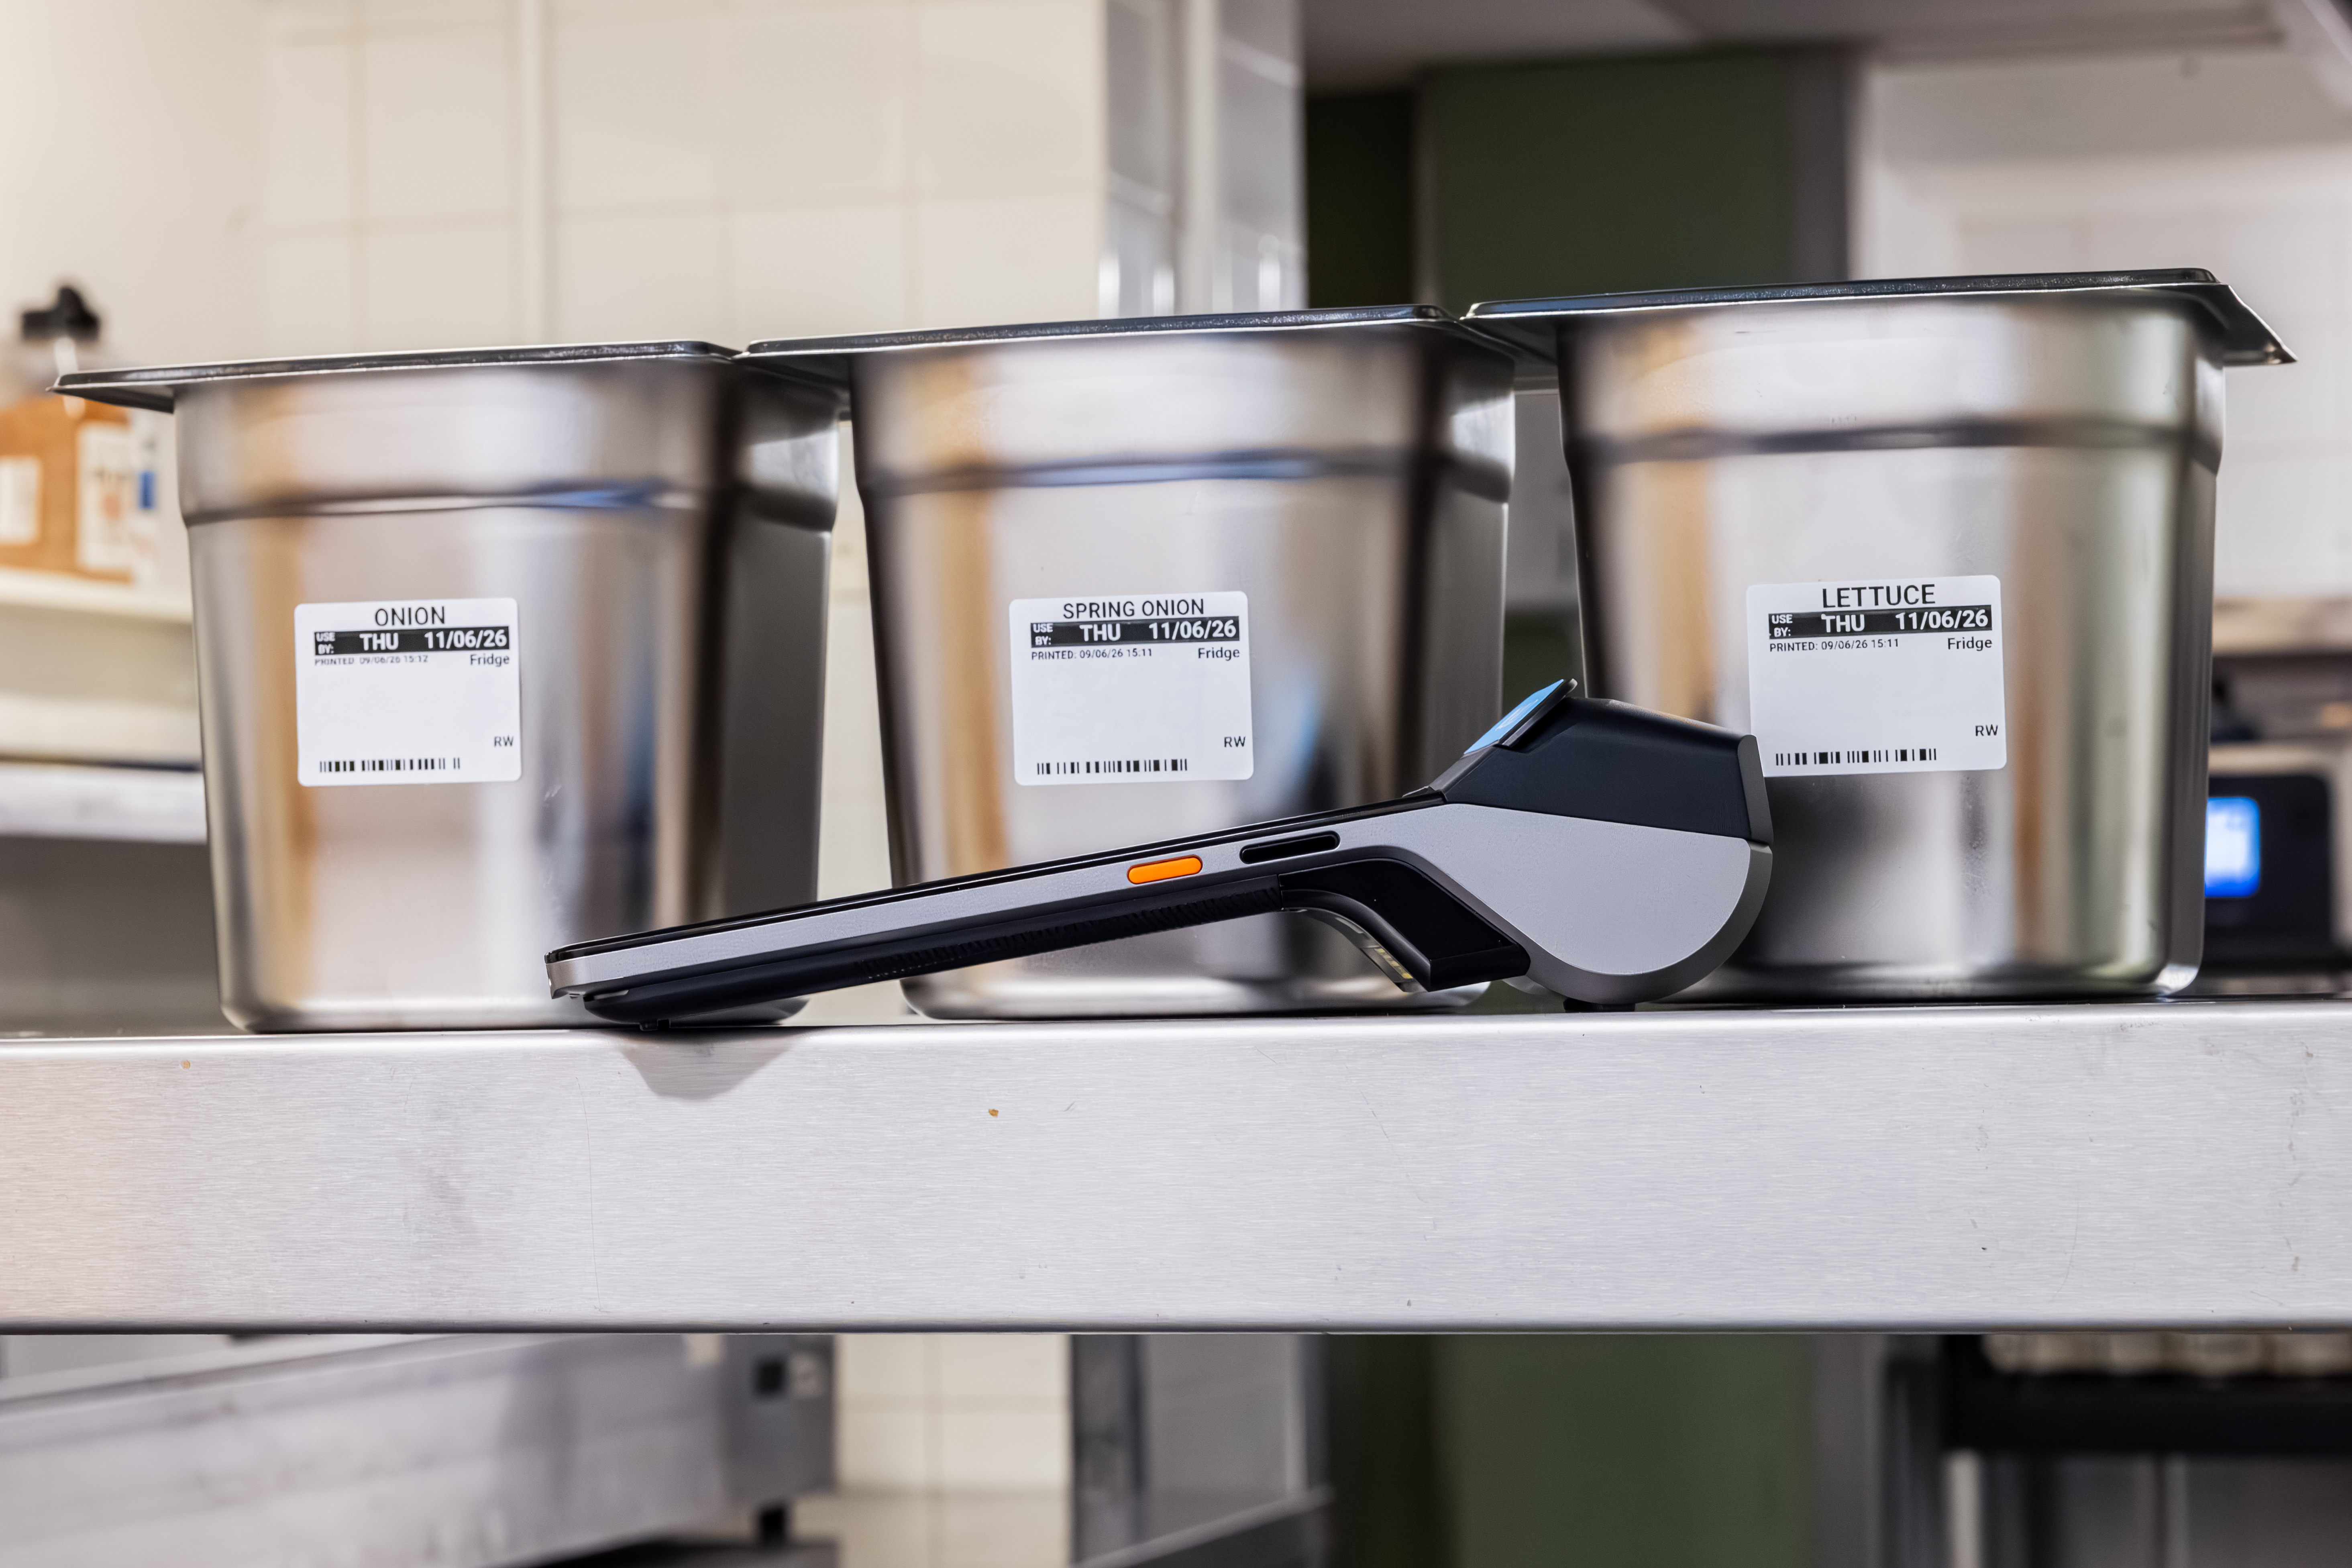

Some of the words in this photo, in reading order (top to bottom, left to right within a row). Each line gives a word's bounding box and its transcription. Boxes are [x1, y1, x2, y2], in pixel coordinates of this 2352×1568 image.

[1822, 584, 1935, 608] LETTUCE
[1064, 601, 1135, 619] SPRING
[1142, 599, 1204, 615] ONION
[375, 606, 445, 626] ONION
[1771, 614, 1793, 624] USE
[1821, 614, 1865, 633] THU
[1895, 609, 1988, 630] 11/06/26
[1033, 623, 1053, 633] USE
[1079, 623, 1121, 641] THU
[1149, 619, 1236, 640] 11/06/26
[1774, 627, 1791, 637] BY:
[316, 632, 335, 642] USE
[359, 633, 399, 651] THU
[424, 629, 507, 648] 11/06/26
[1035, 636, 1052, 646] BY:
[318, 644, 334, 654] BY:
[1770, 642, 1818, 652] PRINTED:
[1821, 640, 1867, 650] 09/06/26
[1871, 638, 1898, 648] 15:11
[1947, 636, 1992, 651] Fridge
[1031, 650, 1077, 660] PRINTED:
[1080, 648, 1123, 659] 09/06/26
[1127, 648, 1152, 657] 15:11
[1198, 647, 1240, 661] Fridge
[470, 654, 510, 667] Fridge
[1975, 724, 1998, 736] RW
[494, 735, 514, 746] RW
[1224, 736, 1246, 747] RW
